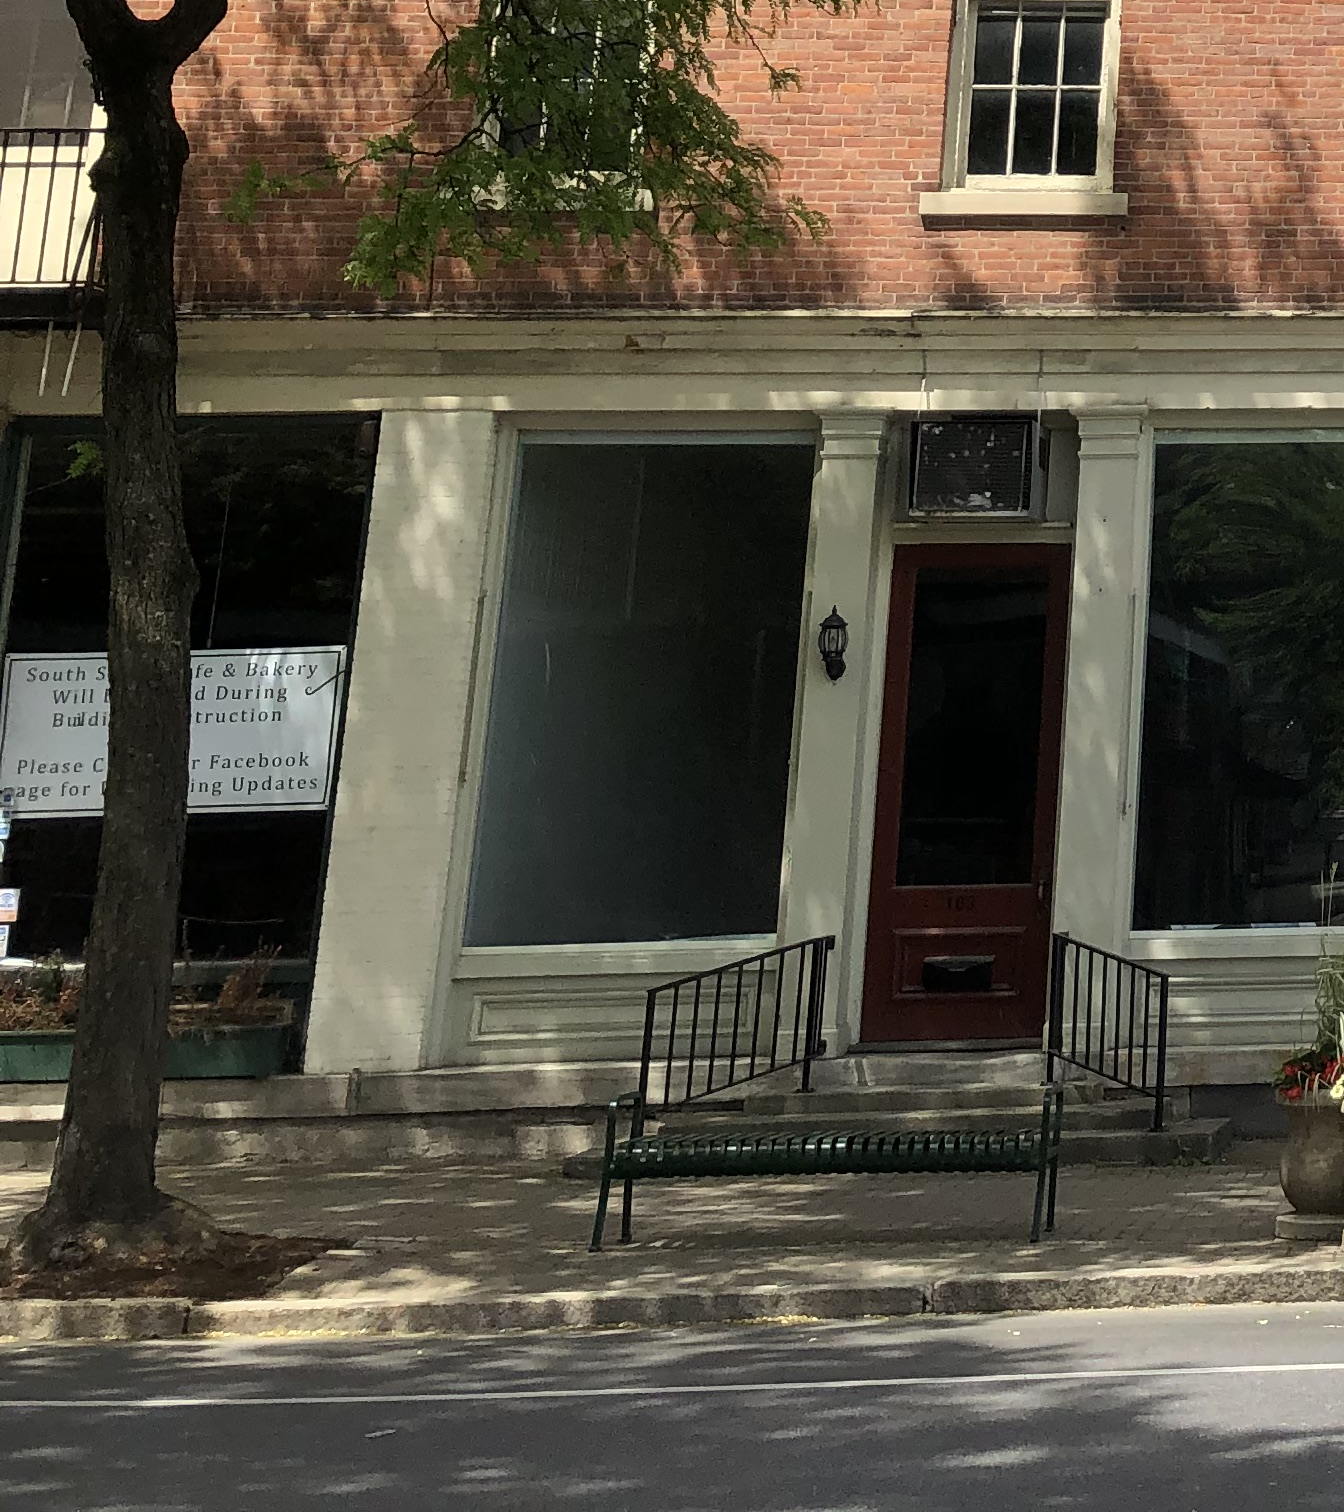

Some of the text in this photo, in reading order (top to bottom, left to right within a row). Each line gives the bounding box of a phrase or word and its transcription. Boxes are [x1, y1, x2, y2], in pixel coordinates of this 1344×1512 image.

[26, 666, 86, 683] South
[194, 663, 214, 679] fe
[222, 662, 236, 678] &
[245, 661, 319, 680] Bakery
[52, 688, 95, 705] Will
[215, 684, 288, 703] During
[52, 708, 283, 728] Buildi truction
[17, 759, 84, 775] Please
[209, 752, 311, 770] Facebook
[15, 785, 52, 802] age
[60, 781, 92, 797] for
[231, 775, 319, 796] Updates
